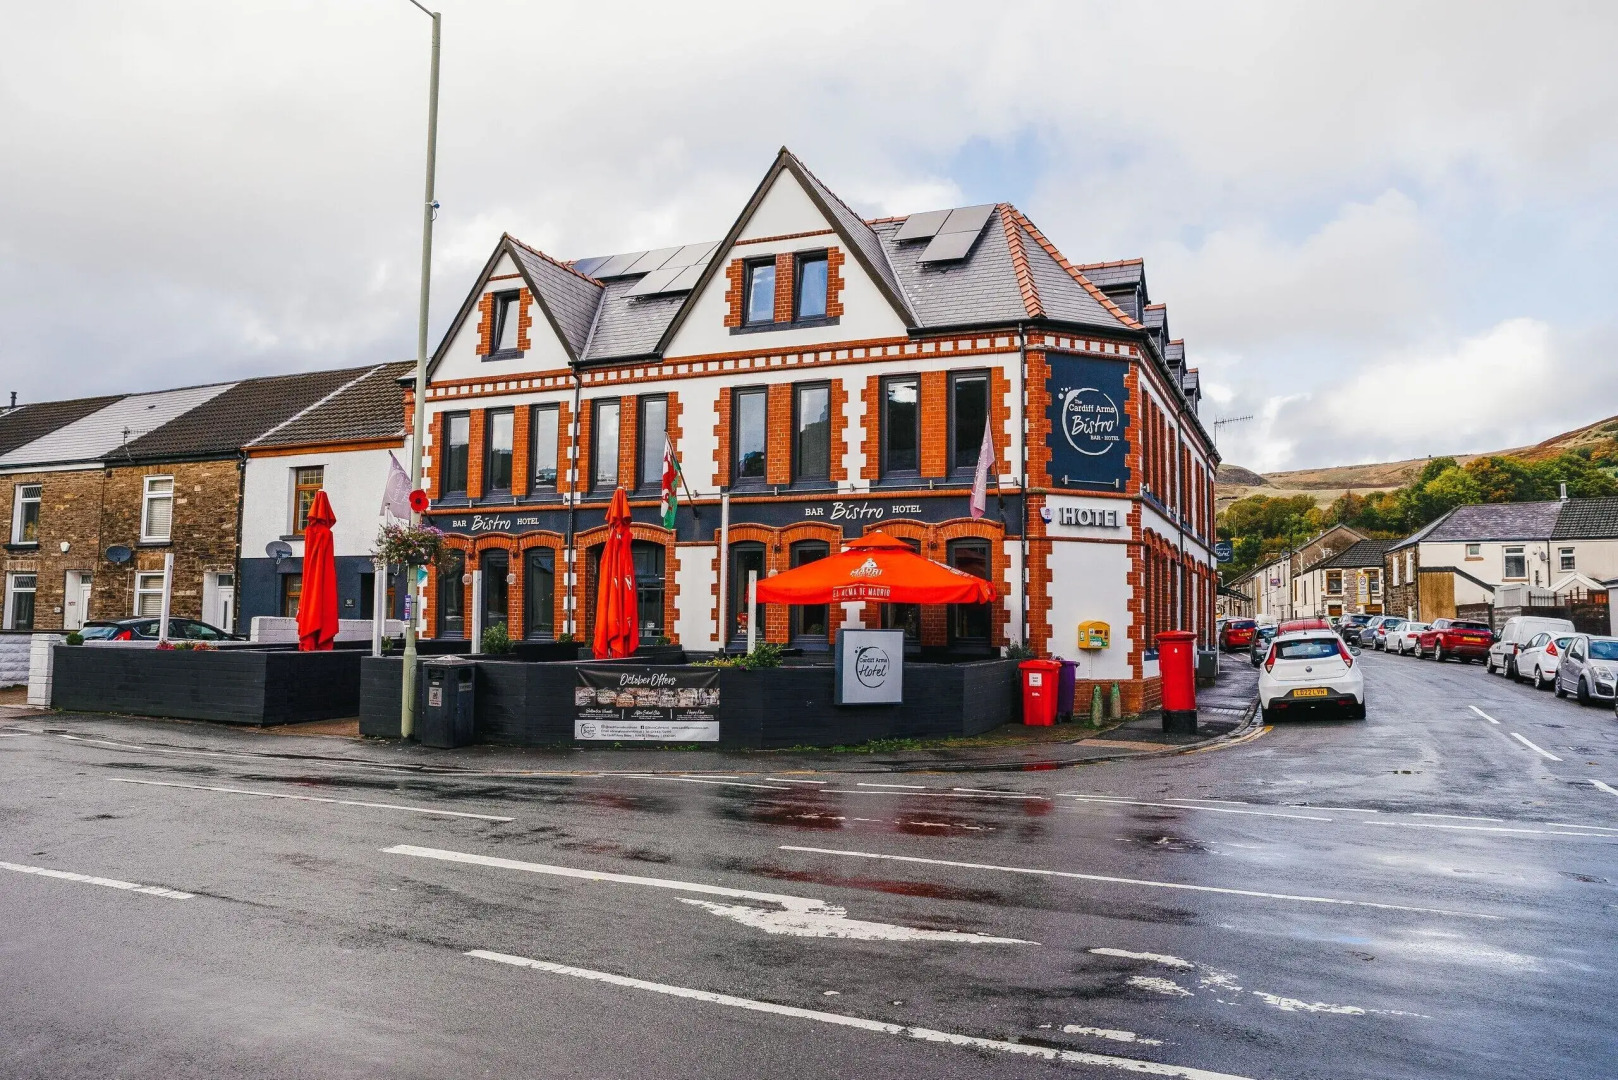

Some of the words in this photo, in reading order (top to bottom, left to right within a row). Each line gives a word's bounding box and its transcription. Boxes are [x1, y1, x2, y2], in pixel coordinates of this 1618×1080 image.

[1068, 403, 1095, 412] Cardiff
[1095, 405, 1115, 414] Arms
[1071, 414, 1115, 436] Bistro
[805, 507, 824, 516] BAR
[830, 501, 884, 520] Bistro
[892, 505, 922, 514] HOTEL
[1061, 506, 1124, 527] HOTEL
[452, 520, 467, 528] BAR
[471, 514, 511, 531] Bistro
[516, 517, 540, 526] HOTEL
[841, 587, 857, 597] ALMA
[859, 587, 866, 596] DE
[868, 587, 891, 597] MADRID
[858, 664, 887, 677] Hotel
[619, 672, 651, 686] October
[650, 672, 677, 687] Offers
